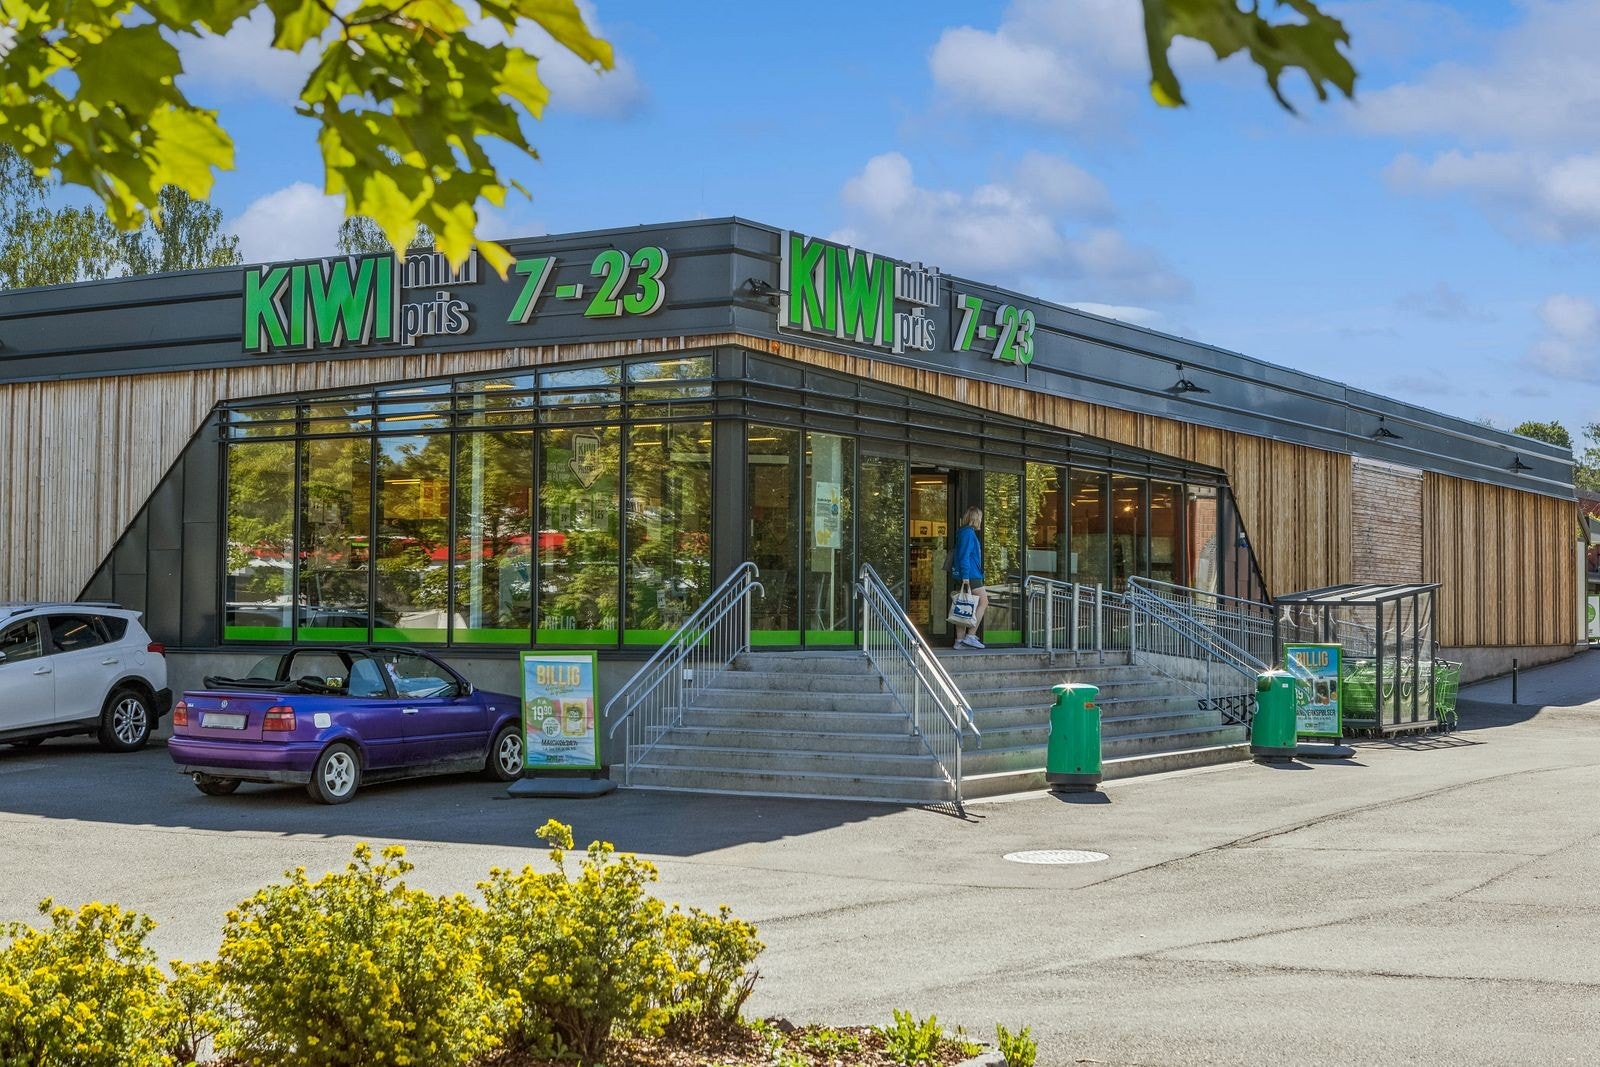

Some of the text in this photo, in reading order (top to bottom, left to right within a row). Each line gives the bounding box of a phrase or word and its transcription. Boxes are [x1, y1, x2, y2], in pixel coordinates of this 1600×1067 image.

[242, 253, 400, 353] KIWI
[780, 231, 896, 347] KIWI
[895, 261, 941, 307] mini
[401, 290, 469, 346] pris
[891, 307, 936, 354] pris
[536, 664, 582, 687] BILLIG
[1295, 650, 1329, 667] BILLIG
